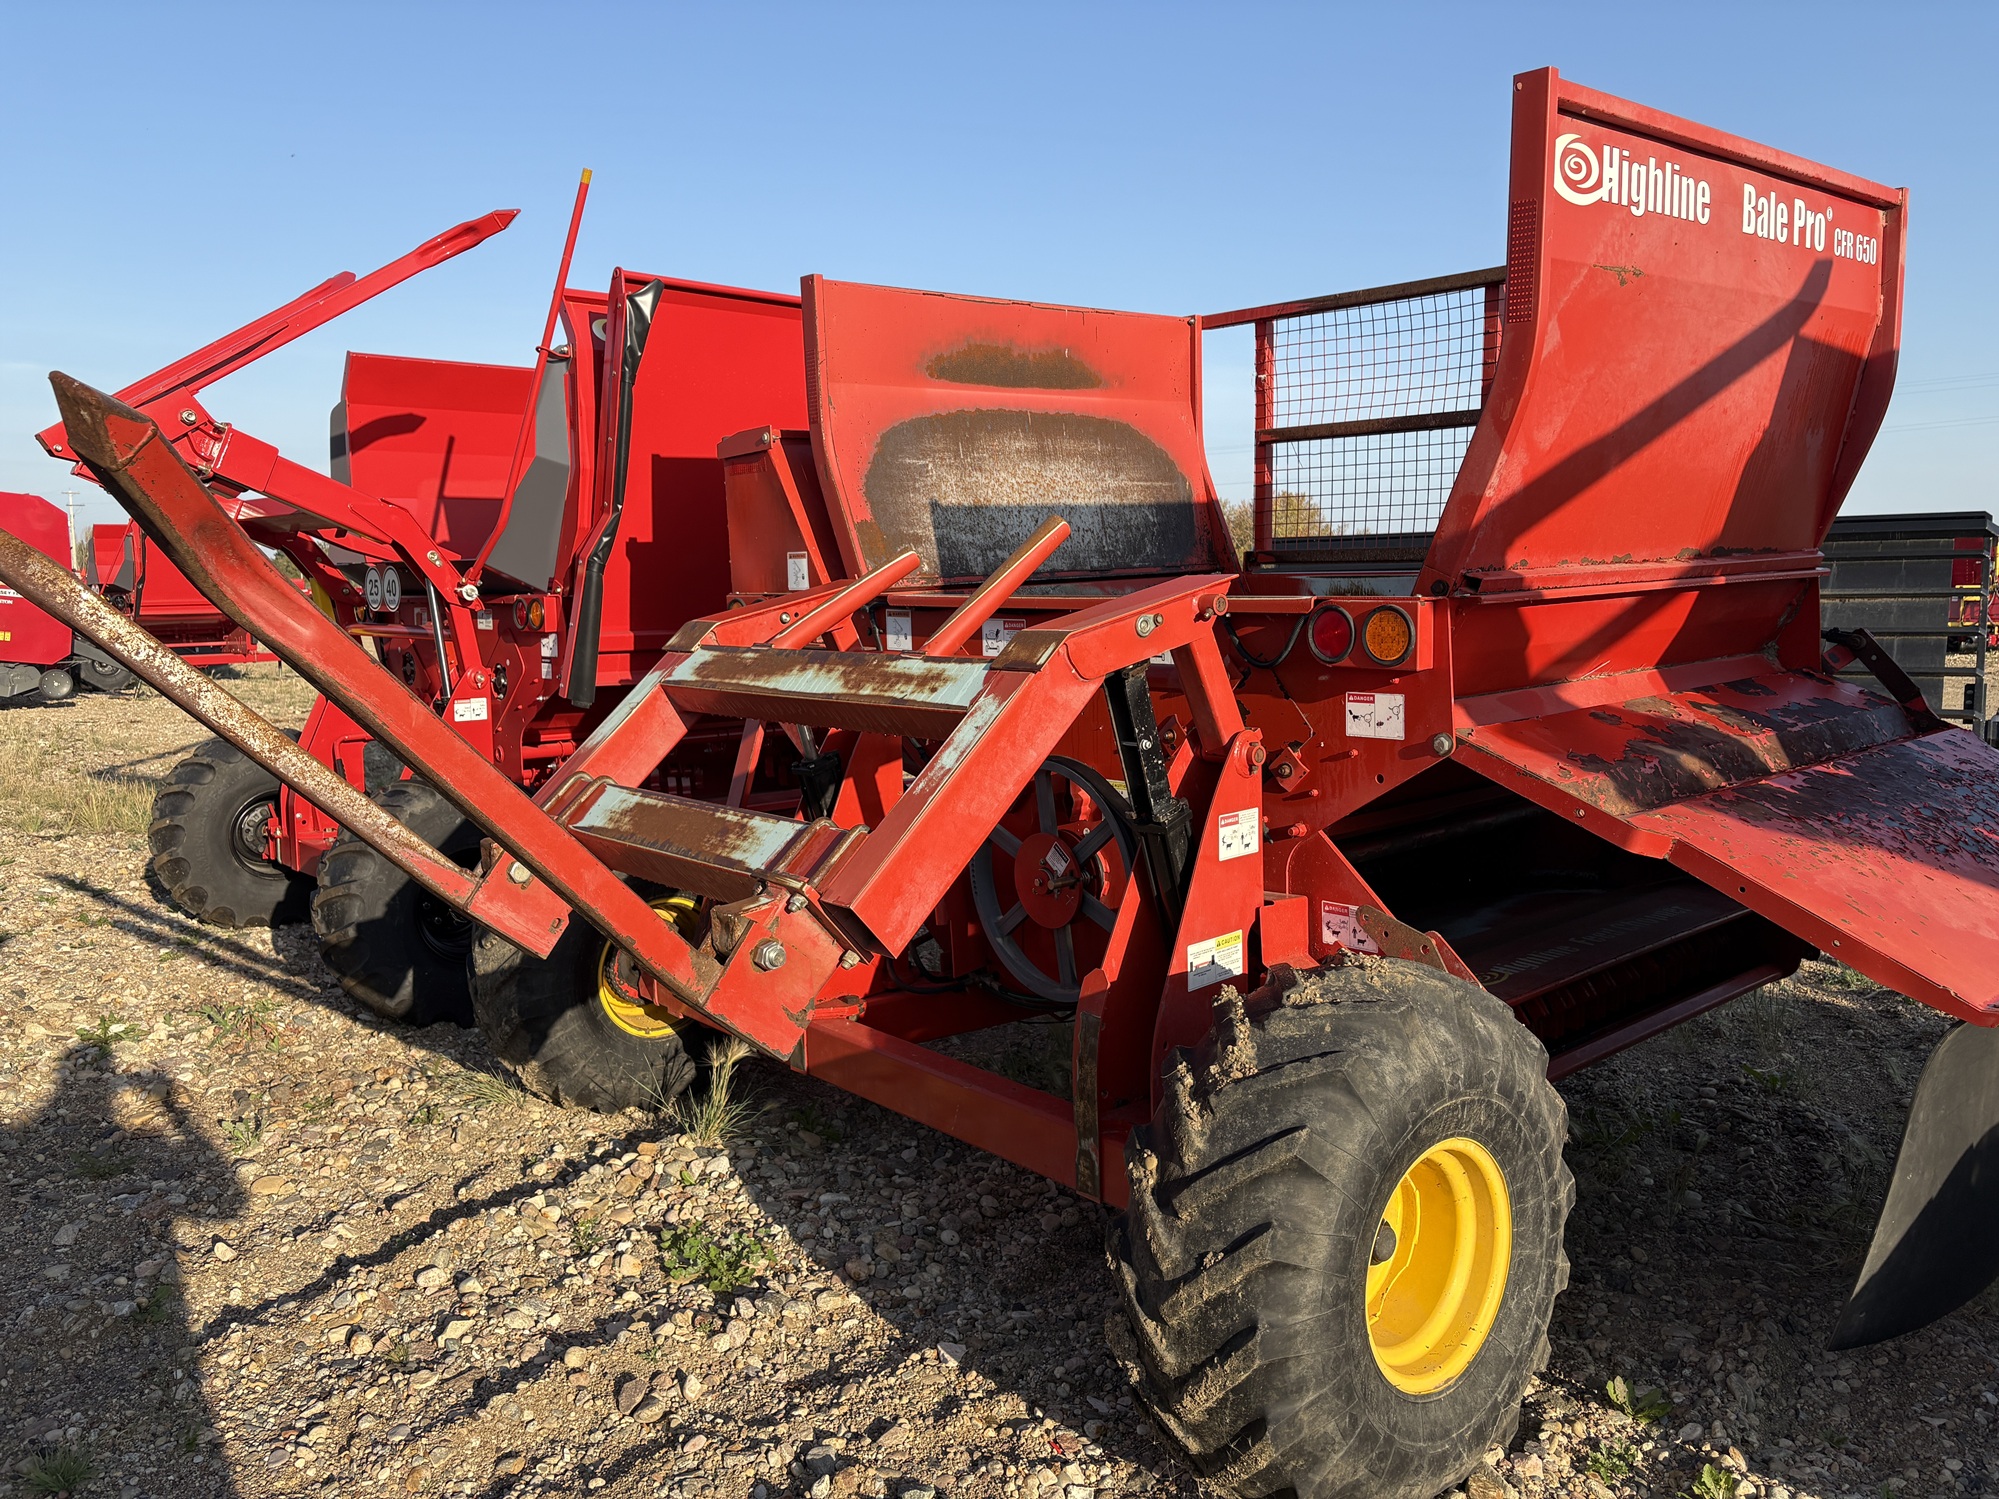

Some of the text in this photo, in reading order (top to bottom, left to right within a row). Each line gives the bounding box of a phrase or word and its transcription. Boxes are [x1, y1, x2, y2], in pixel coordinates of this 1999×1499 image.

[1601, 144, 1712, 226] Highline
[1742, 182, 1789, 243] Bale
[1833, 227, 1854, 260] CFR
[1855, 233, 1878, 266] 650
[368, 579, 379, 596] 25
[386, 579, 397, 597] 40
[1353, 694, 1374, 702] DANGER
[1328, 904, 1348, 914] DANGER
[1221, 934, 1241, 946] CAUTION
